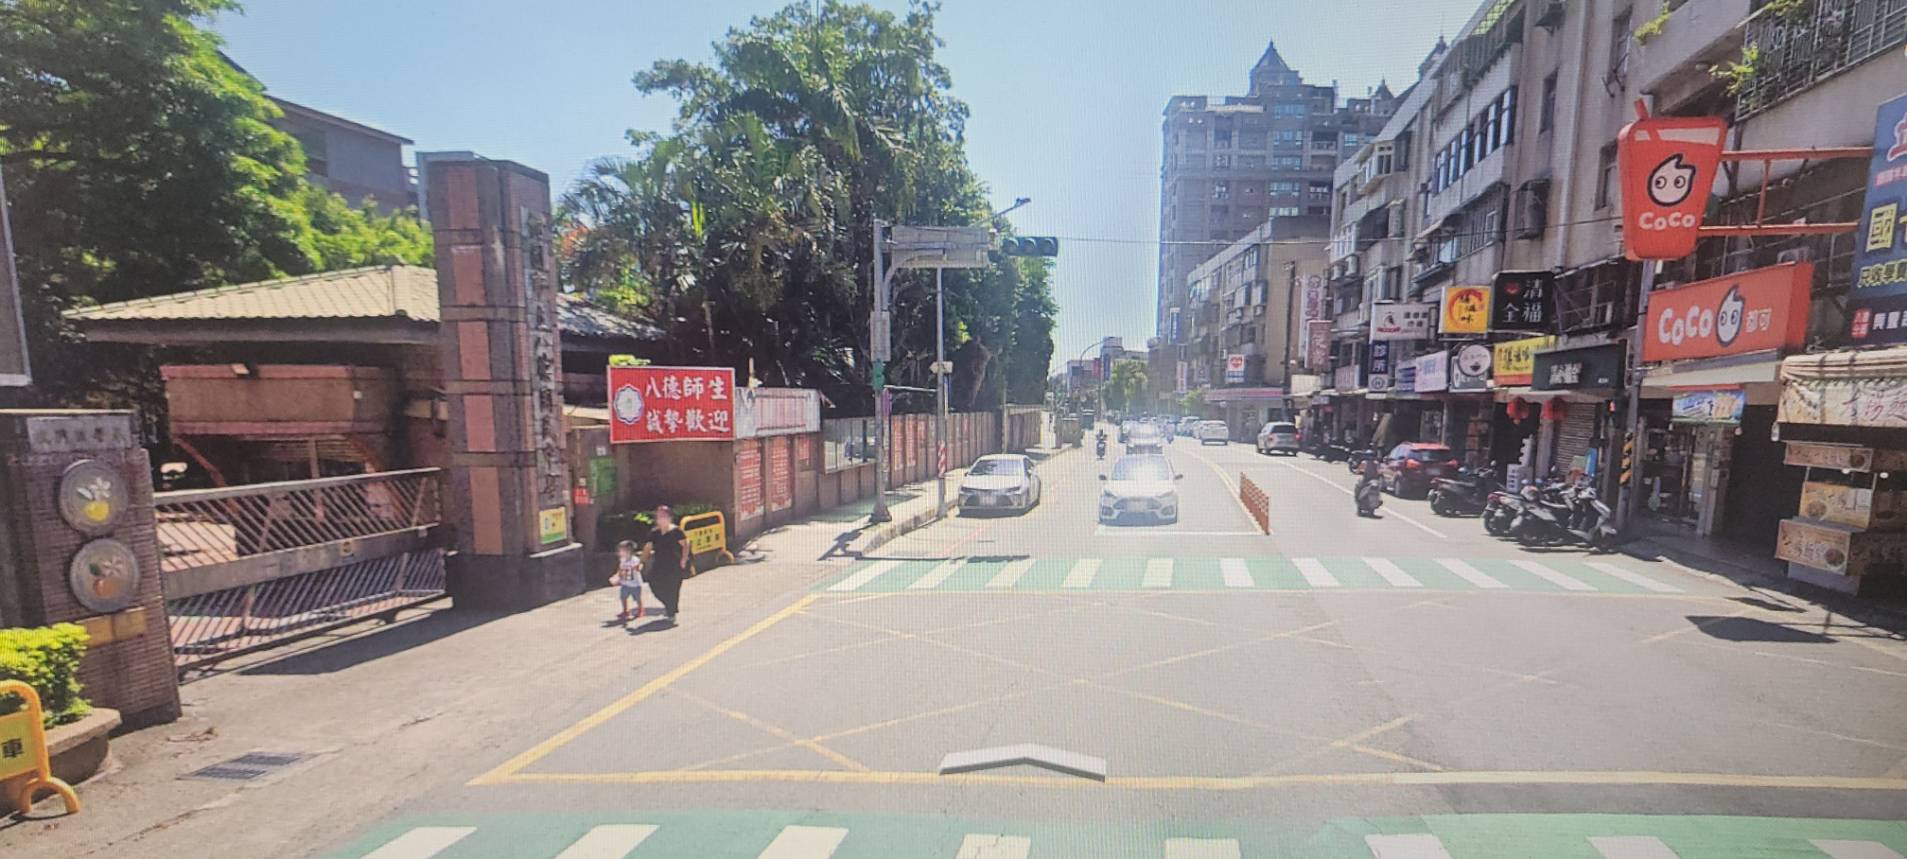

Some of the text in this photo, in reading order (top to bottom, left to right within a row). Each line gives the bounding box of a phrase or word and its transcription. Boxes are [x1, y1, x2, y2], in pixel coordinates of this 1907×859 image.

[1638, 212, 1696, 231] CoCo
[1657, 305, 1714, 346] CoCo
[645, 376, 728, 400] 八德師生
[646, 408, 731, 434] 誠摯歡迎
[1, 737, 24, 758] 車
